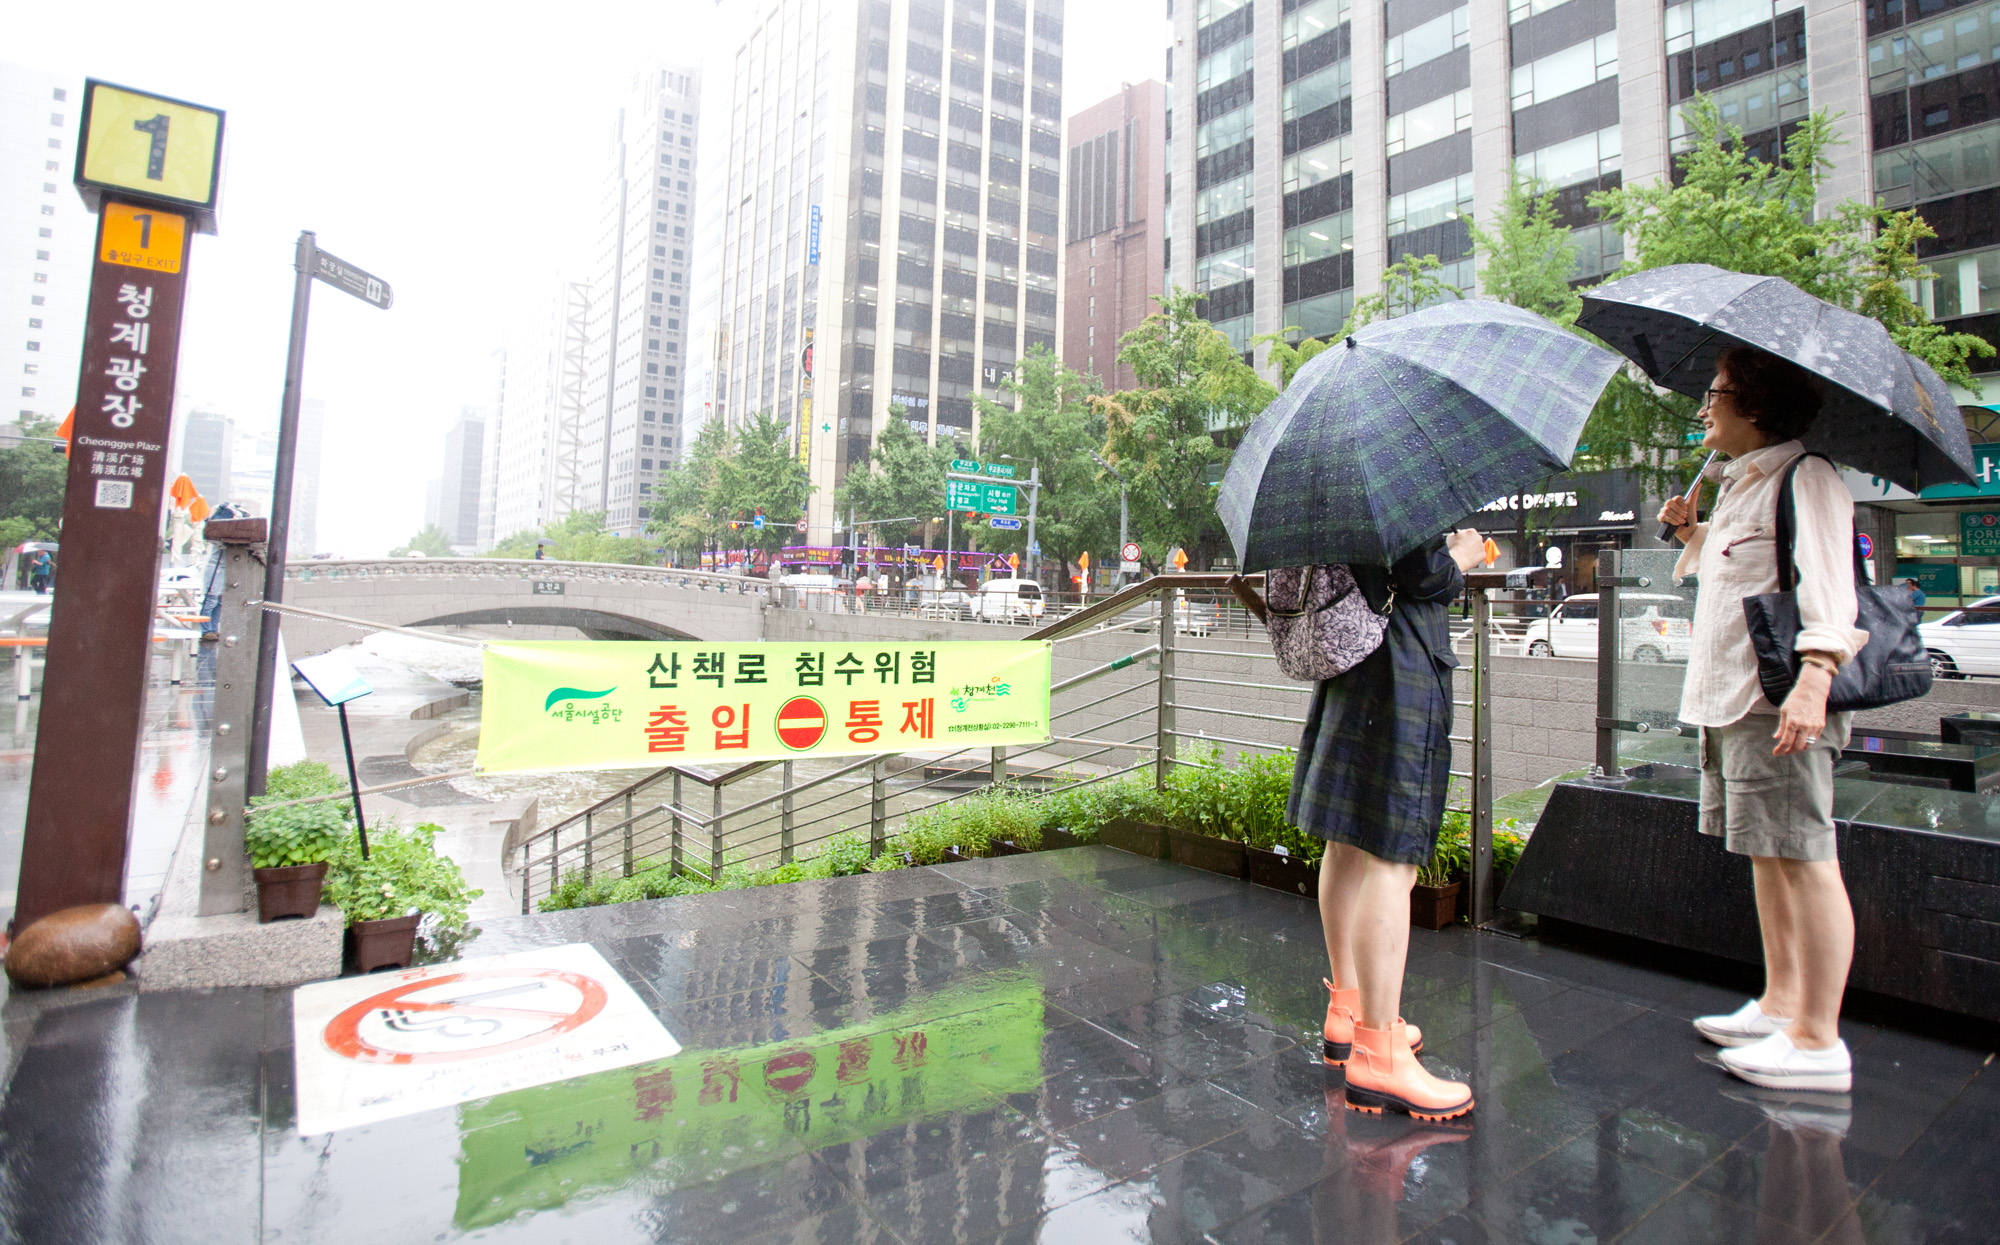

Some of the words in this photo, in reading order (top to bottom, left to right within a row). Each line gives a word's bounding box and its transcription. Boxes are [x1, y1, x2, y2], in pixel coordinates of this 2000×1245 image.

[134, 114, 170, 182] 1
[133, 214, 152, 249] 1
[108, 249, 144, 264] 출입구
[147, 257, 176, 269] EXIT
[101, 283, 153, 428] 청계광장
[78, 436, 135, 450] Cheonggye
[136, 441, 161, 451] Plaza
[957, 483, 976, 492] 군자교
[1598, 510, 1635, 521] Black
[646, 651, 768, 689] 산책로
[795, 650, 936, 687] 침수위험
[963, 684, 996, 697] 청계천
[551, 702, 623, 725] 서울시설공단
[644, 703, 751, 753] 출입
[845, 697, 935, 743] 통제
